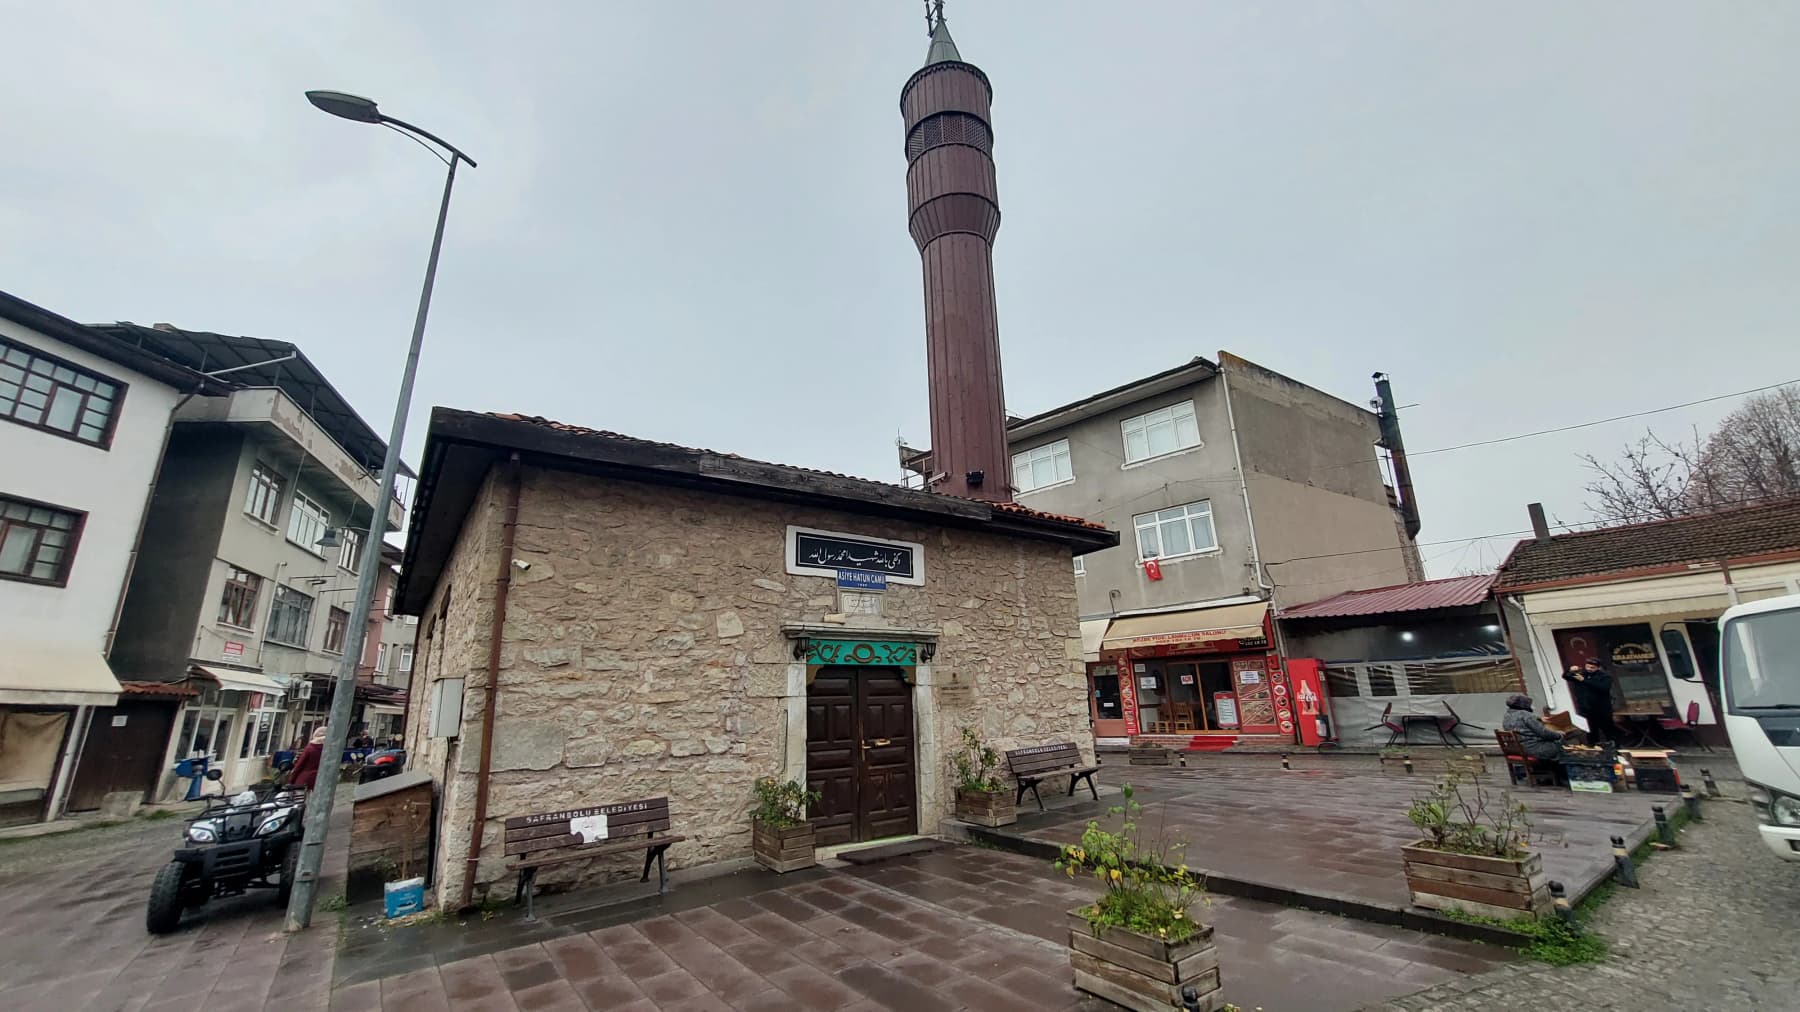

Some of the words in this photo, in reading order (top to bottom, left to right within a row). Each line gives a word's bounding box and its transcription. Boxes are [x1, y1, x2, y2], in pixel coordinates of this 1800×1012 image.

[838, 569, 853, 582] ASİYE
[853, 572, 870, 583] HATUN
[526, 809, 591, 824] SAFRANBOLU
[594, 803, 647, 815] BELEDİYESİ
